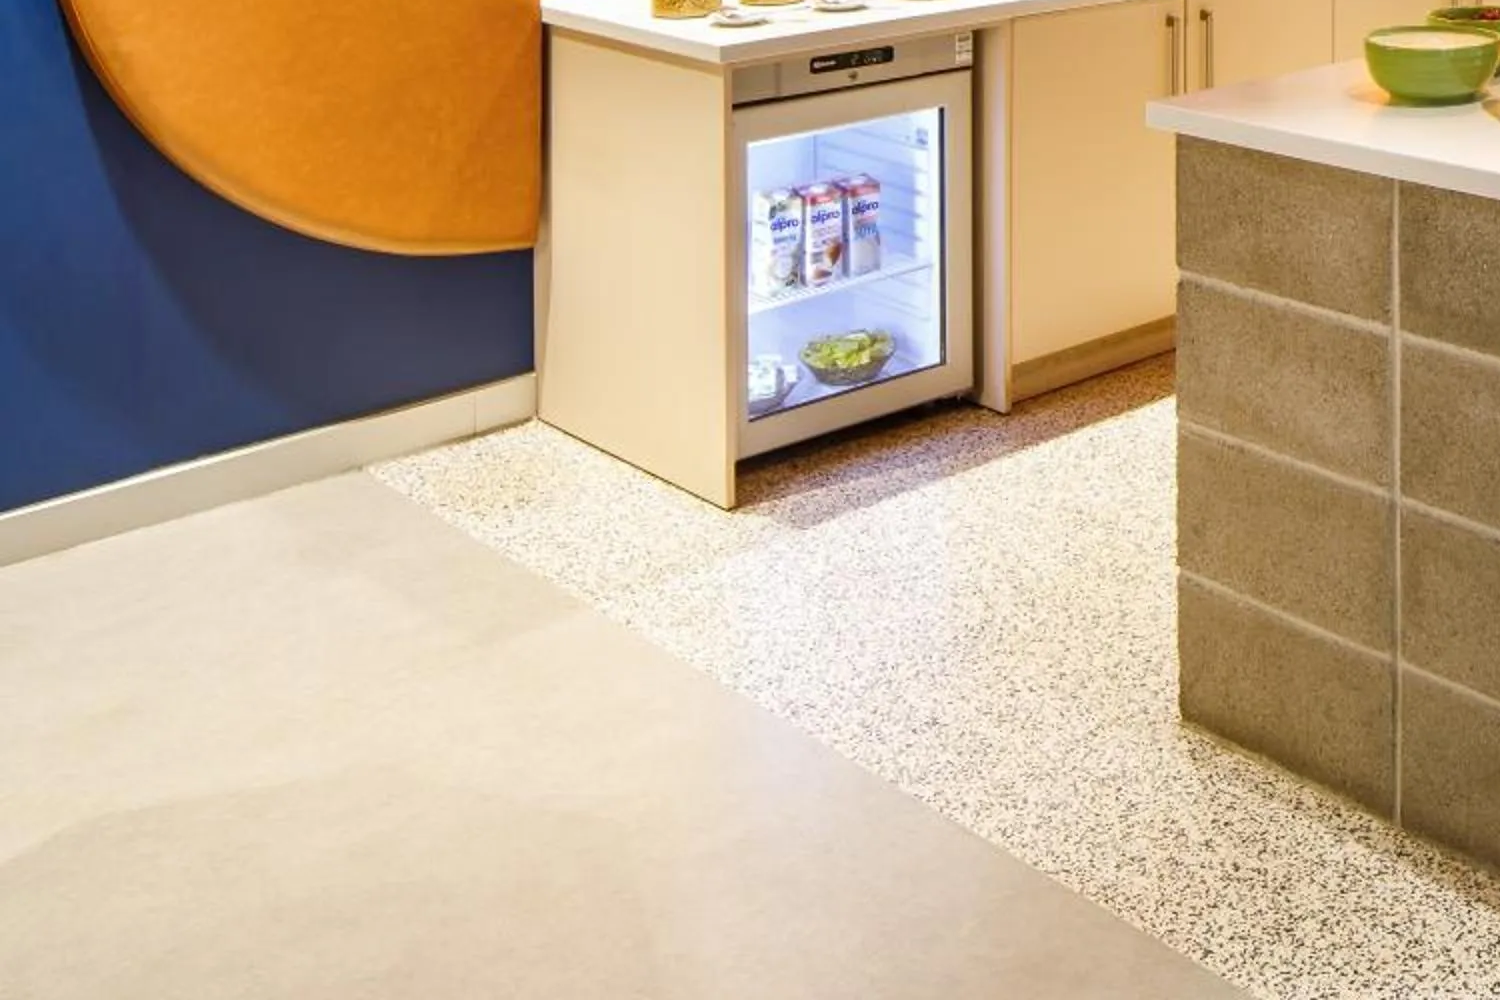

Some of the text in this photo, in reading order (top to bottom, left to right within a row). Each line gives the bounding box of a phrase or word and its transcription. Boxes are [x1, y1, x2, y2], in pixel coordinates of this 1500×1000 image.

[851, 200, 879, 215] alpro
[770, 217, 799, 232] alpro
[811, 210, 840, 224] alpro
